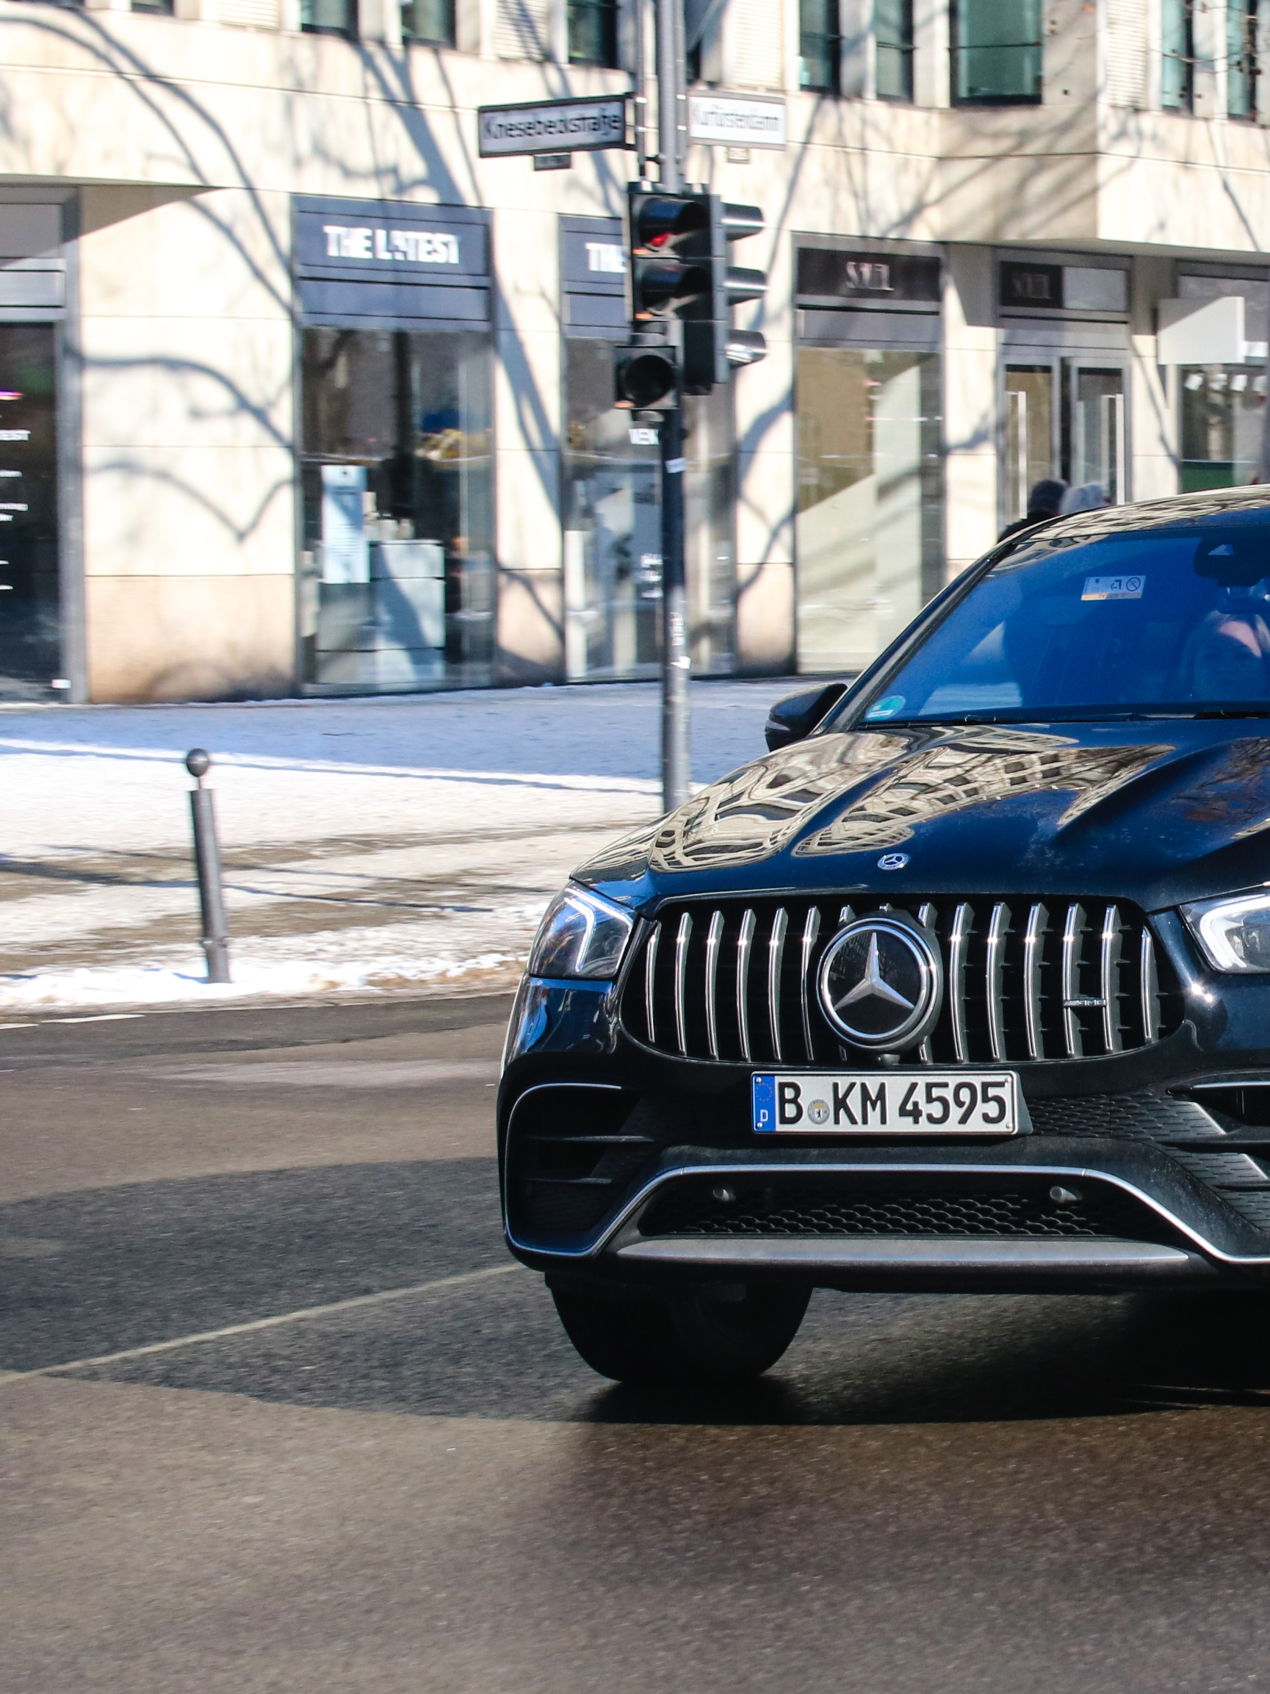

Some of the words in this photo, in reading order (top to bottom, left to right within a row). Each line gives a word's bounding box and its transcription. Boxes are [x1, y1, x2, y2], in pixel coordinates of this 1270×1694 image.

[323, 225, 372, 260] THE
[373, 229, 462, 264] LATEST
[760, 1109, 769, 1122] D
[778, 1081, 803, 1125] B
[832, 1082, 887, 1125] KM
[898, 1081, 1006, 1125] 4595
